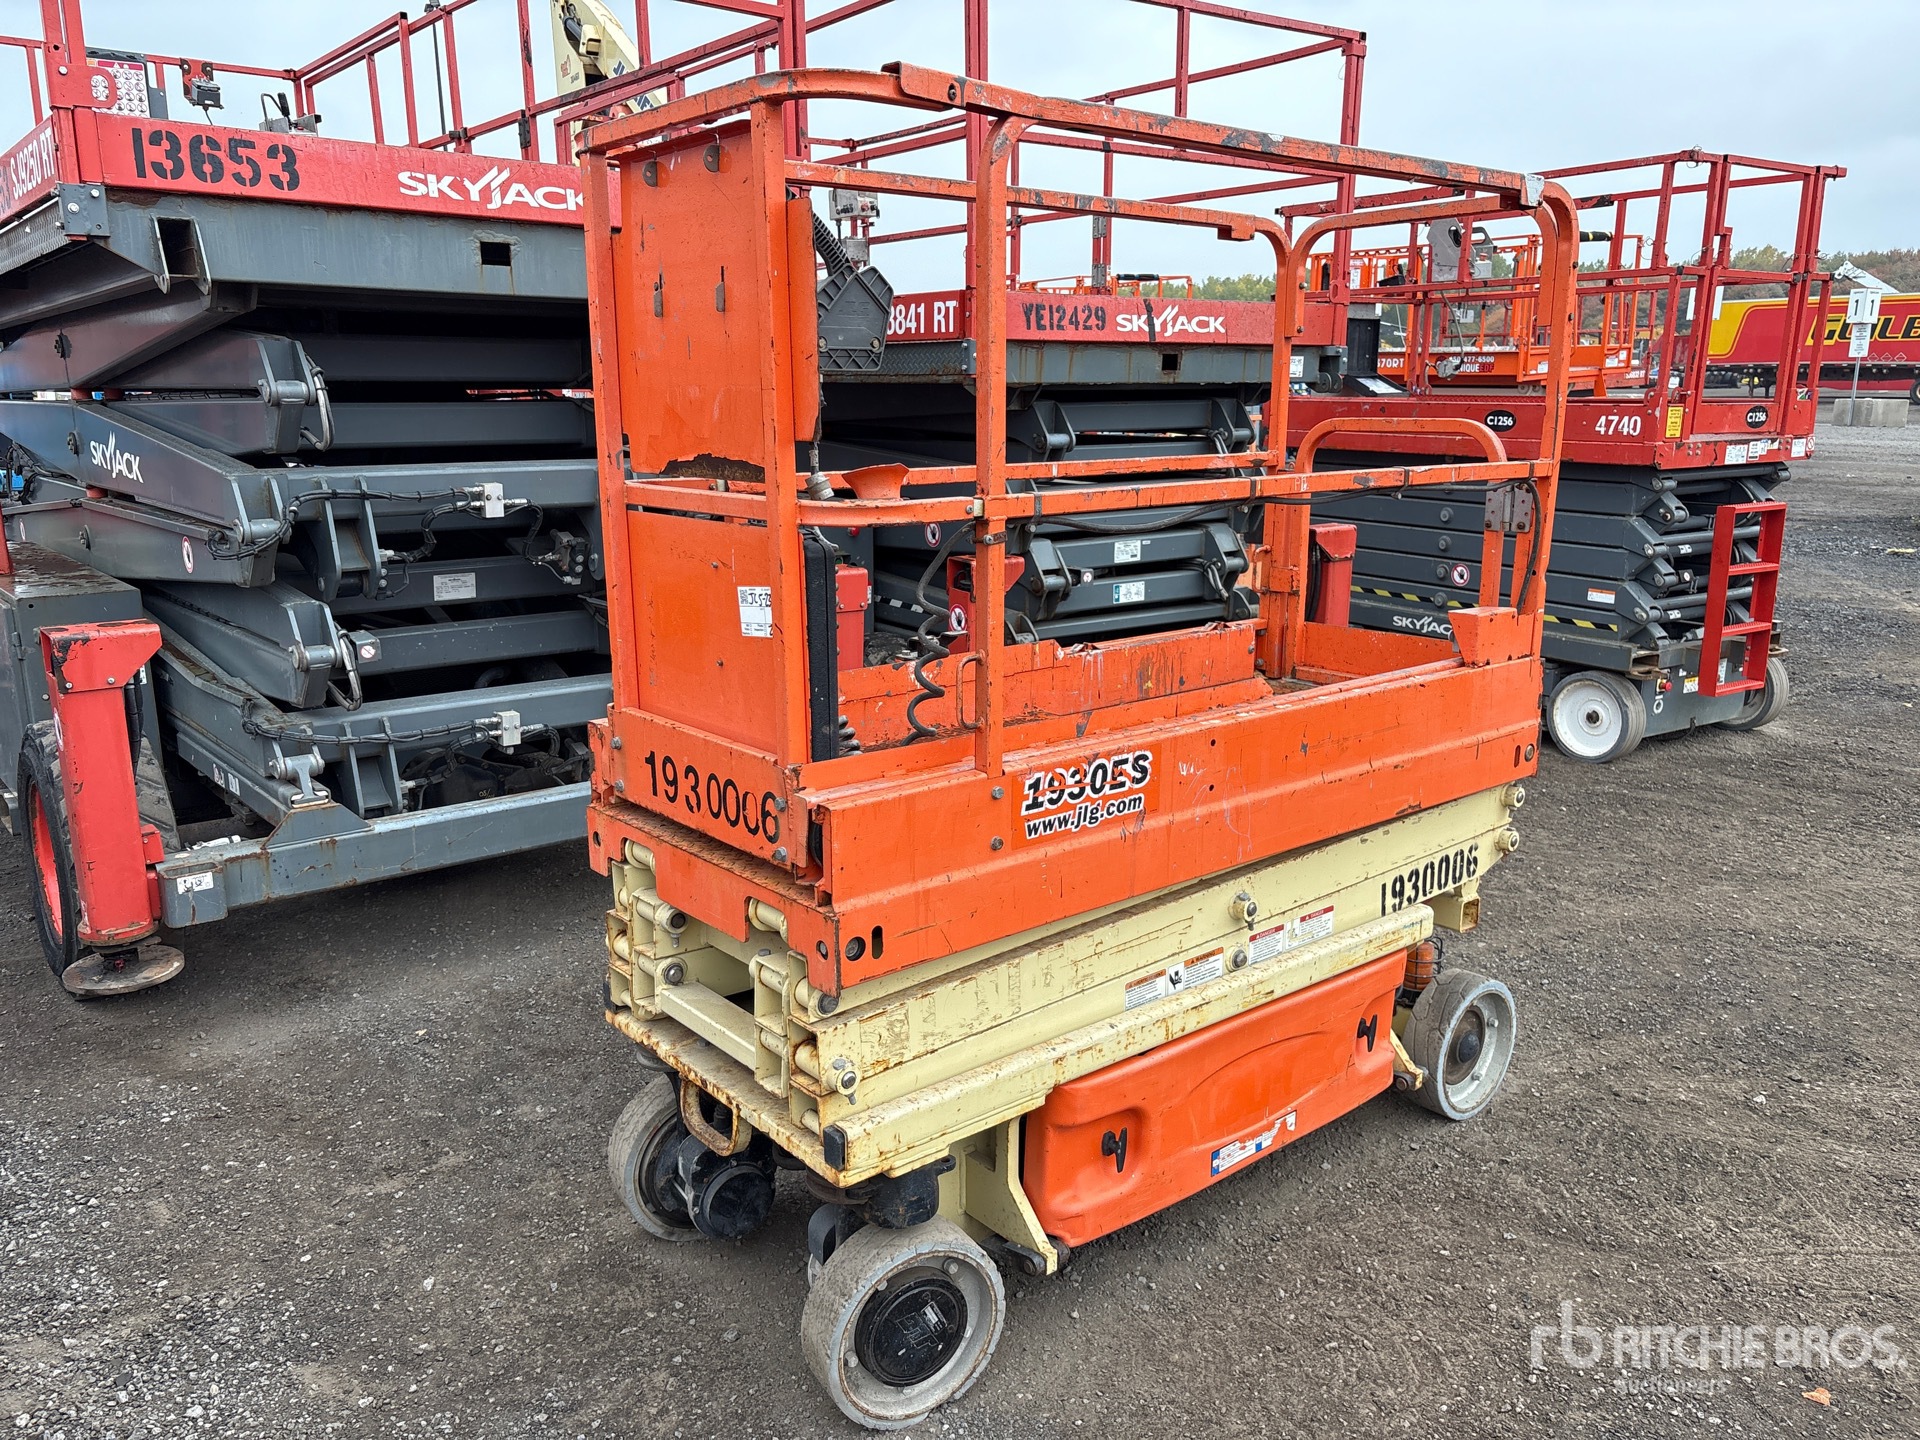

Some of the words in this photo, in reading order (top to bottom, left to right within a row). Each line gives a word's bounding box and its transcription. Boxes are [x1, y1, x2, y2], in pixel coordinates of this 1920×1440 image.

[10, 139, 42, 200] SJ9250
[40, 127, 55, 179] RT
[132, 128, 300, 191] 13653
[934, 300, 957, 333] RT
[1115, 304, 1226, 337] SKYJACK
[1595, 415, 1641, 436] 4740
[90, 430, 144, 484] SKYJACK
[644, 750, 781, 845] 1930006
[1022, 752, 1152, 814] 1930ES
[1025, 794, 1144, 838] www.jlg.com
[1380, 842, 1480, 917] 1930006
